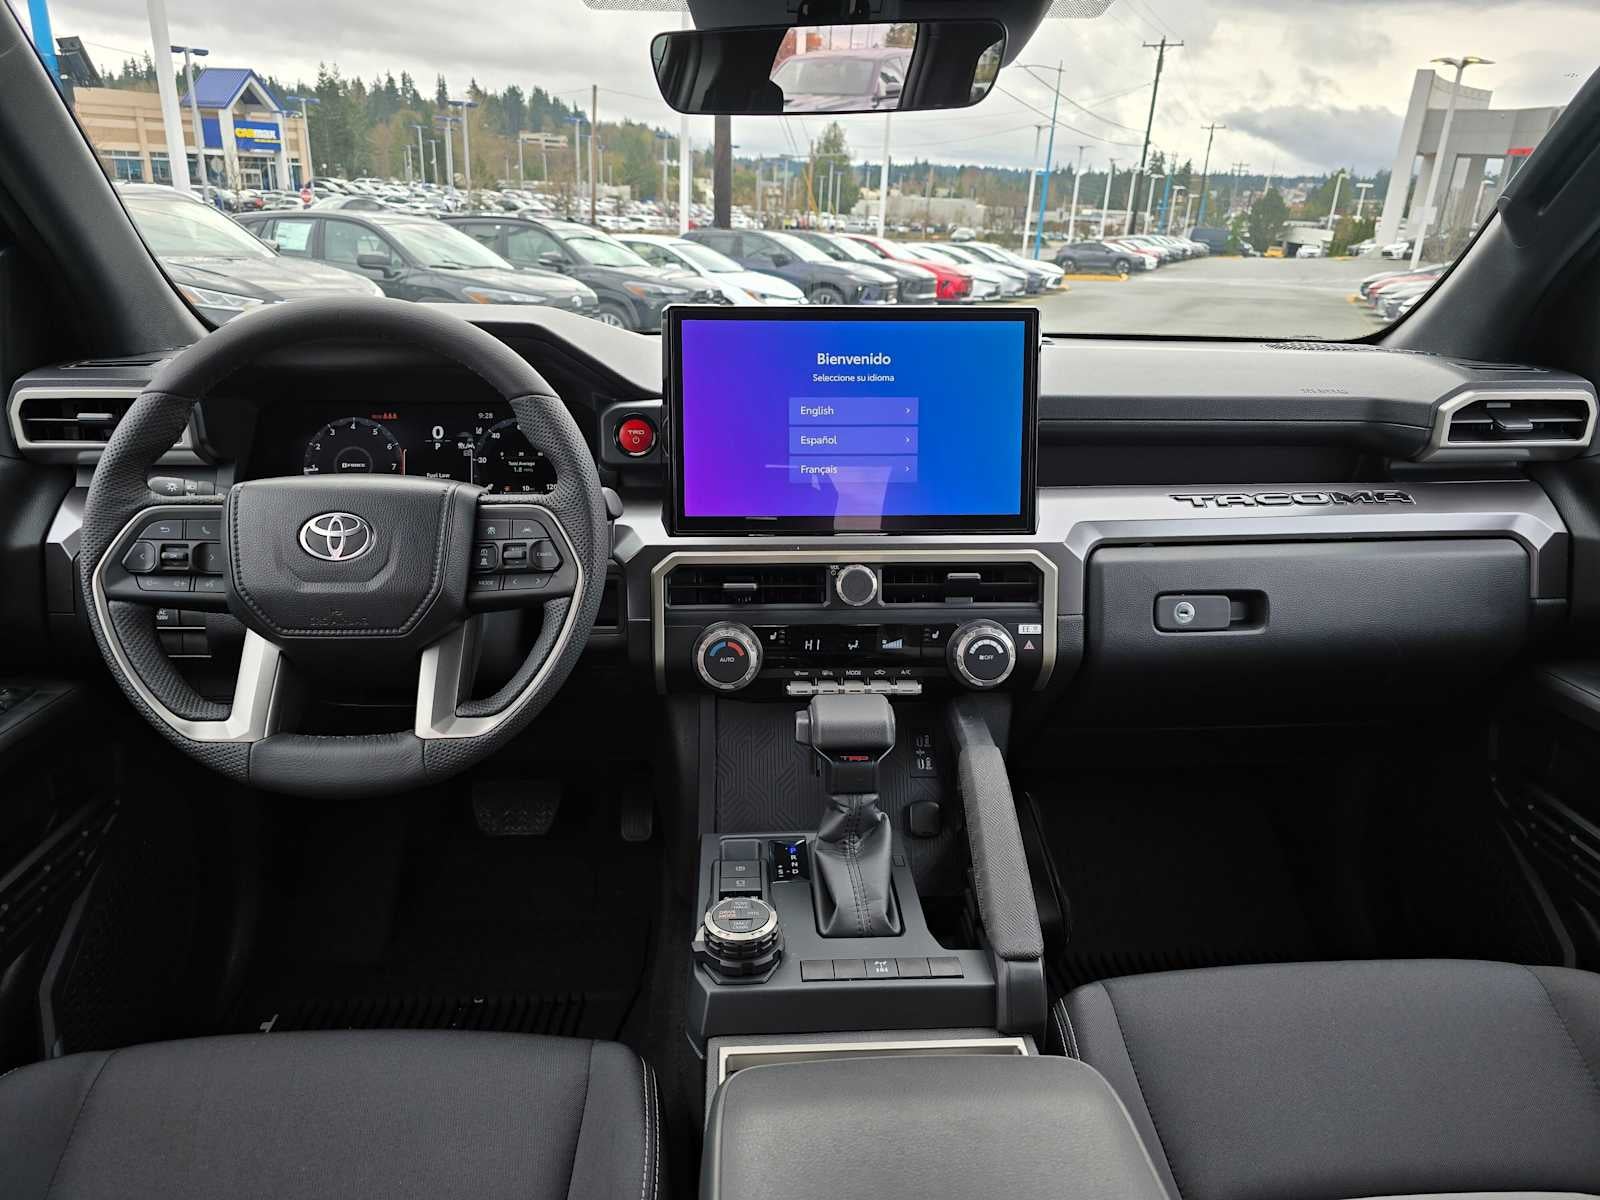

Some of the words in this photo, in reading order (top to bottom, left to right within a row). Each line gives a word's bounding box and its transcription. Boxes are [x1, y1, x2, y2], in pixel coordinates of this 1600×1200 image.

[817, 352, 891, 365] Bienvenido
[812, 373, 855, 382] Seleccione
[856, 374, 866, 382] su
[867, 373, 895, 382] idioma
[800, 405, 834, 417] English
[432, 425, 444, 439] 0
[387, 442, 393, 450] 6
[435, 442, 441, 450] P
[800, 435, 838, 447] Español
[800, 464, 838, 476] Français
[1169, 489, 1416, 508] TACOMA
[805, 639, 820, 651] HI
